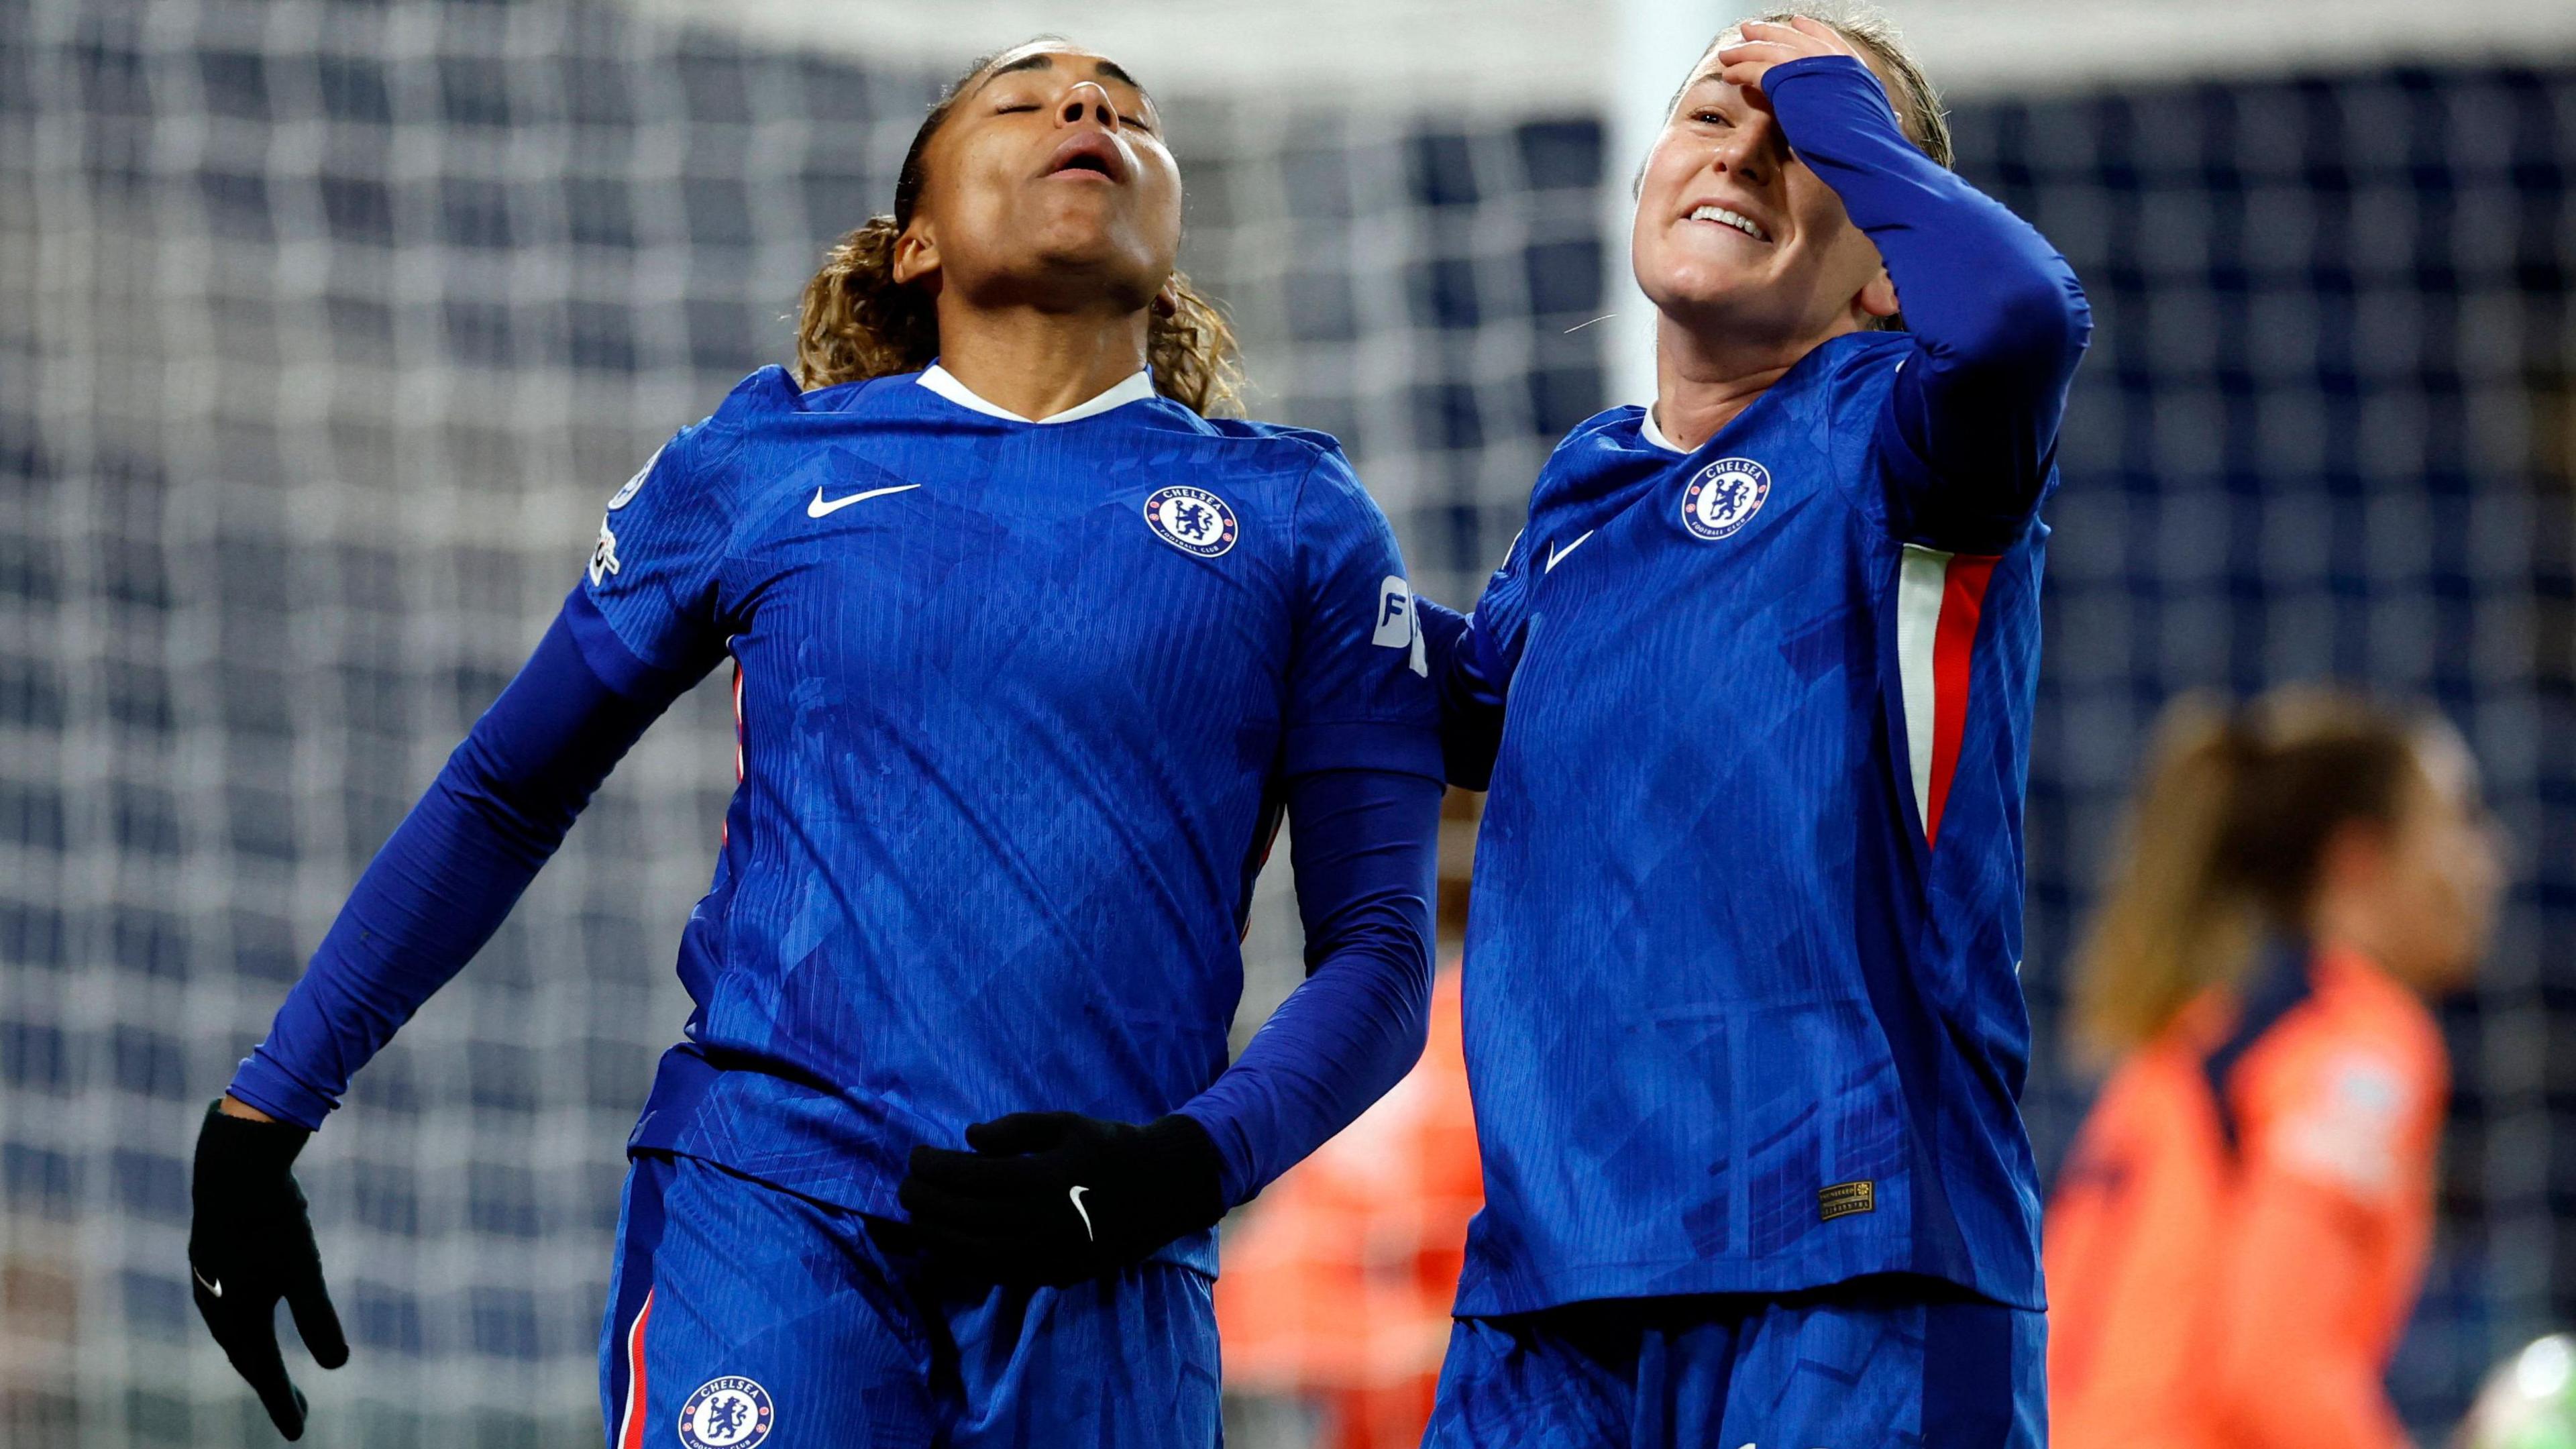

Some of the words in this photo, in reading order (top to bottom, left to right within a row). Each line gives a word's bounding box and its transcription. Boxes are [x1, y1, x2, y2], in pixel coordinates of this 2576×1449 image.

[1706, 462, 1762, 480] CHELSEA
[1163, 489, 1222, 511] CHELSEA
[1692, 521, 1723, 535] FOOTBALL
[1727, 518, 1745, 532] CLUB
[1161, 529, 1197, 551] FOOTBALL
[700, 1379, 759, 1399] CHELSEA
